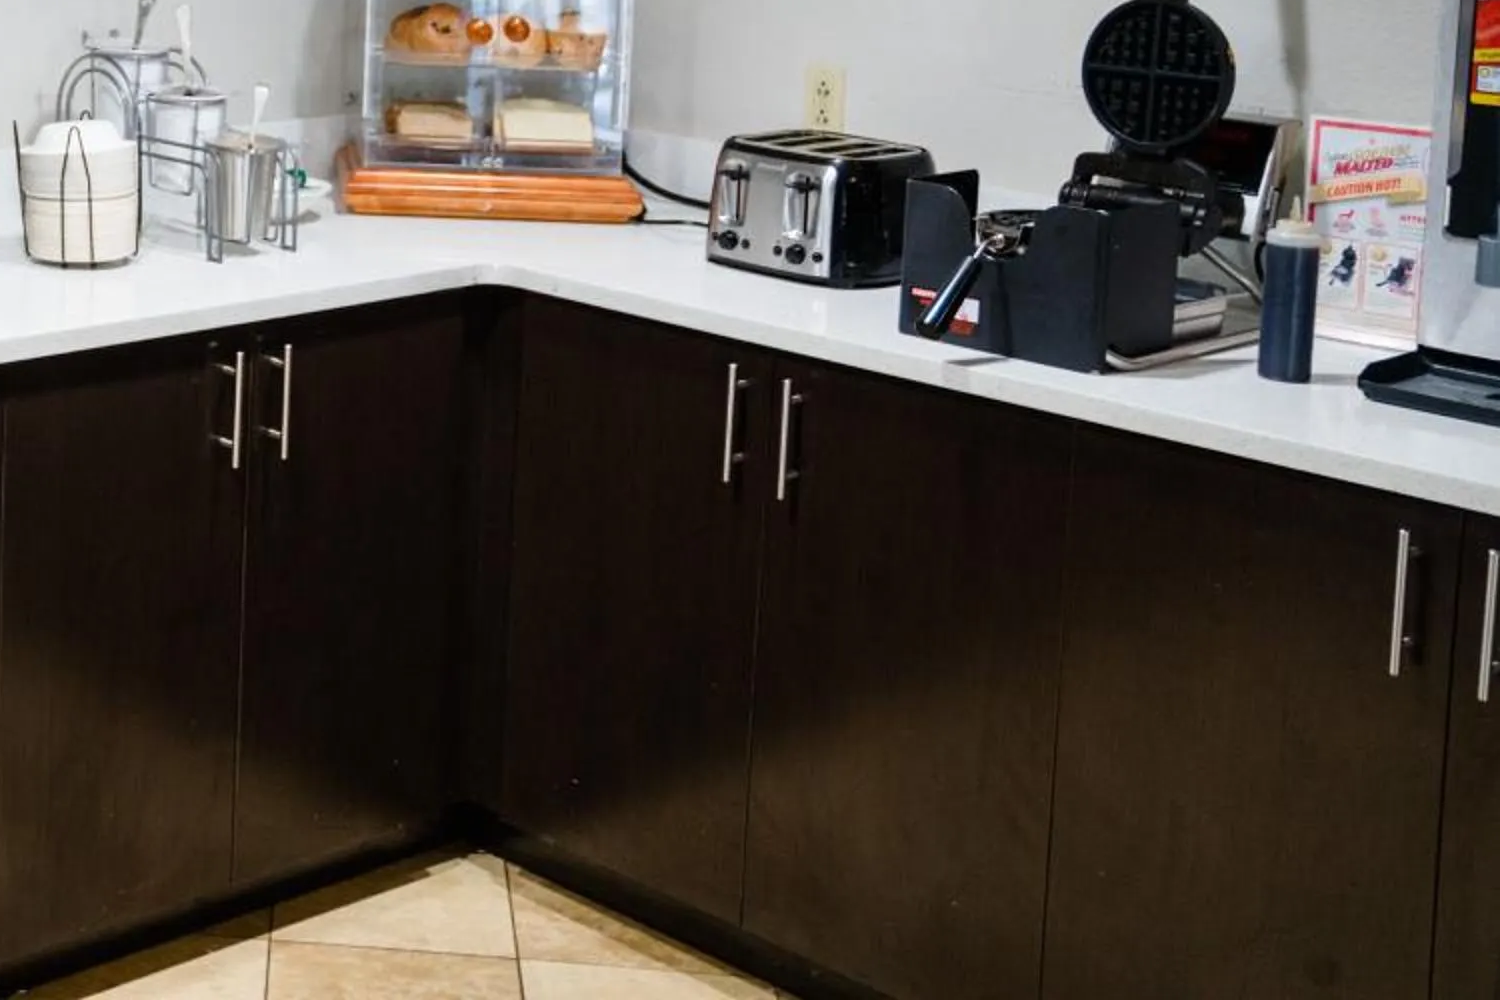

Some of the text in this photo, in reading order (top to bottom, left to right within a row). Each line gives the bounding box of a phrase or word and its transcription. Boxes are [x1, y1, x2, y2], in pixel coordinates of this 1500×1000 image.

[1334, 156, 1394, 174] MALTED
[1327, 177, 1401, 198] CAUTION HOT!
